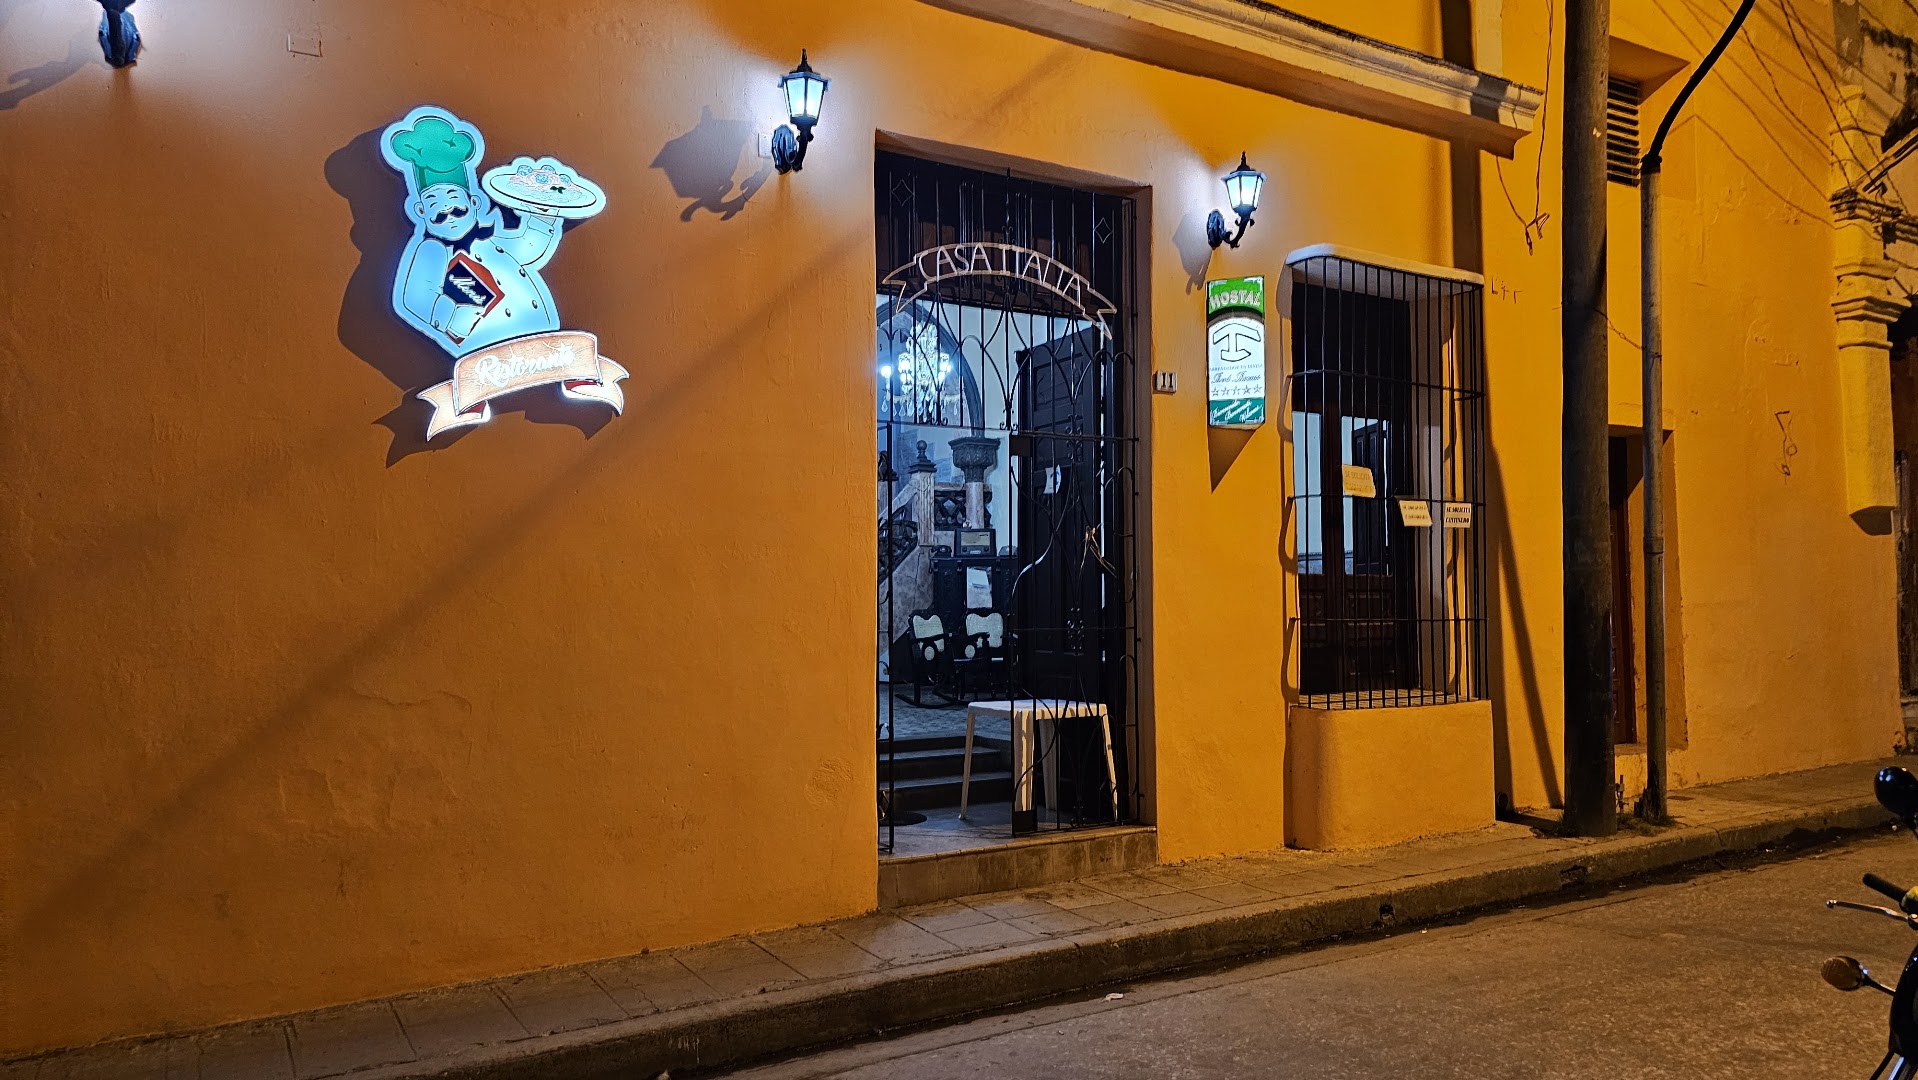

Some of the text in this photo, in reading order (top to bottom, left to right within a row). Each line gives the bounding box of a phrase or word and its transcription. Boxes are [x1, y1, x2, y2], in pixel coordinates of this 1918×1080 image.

[918, 243, 1083, 308] CASA ITALIA
[1209, 289, 1262, 310] HOSTAL
[1161, 371, 1174, 388] 11
